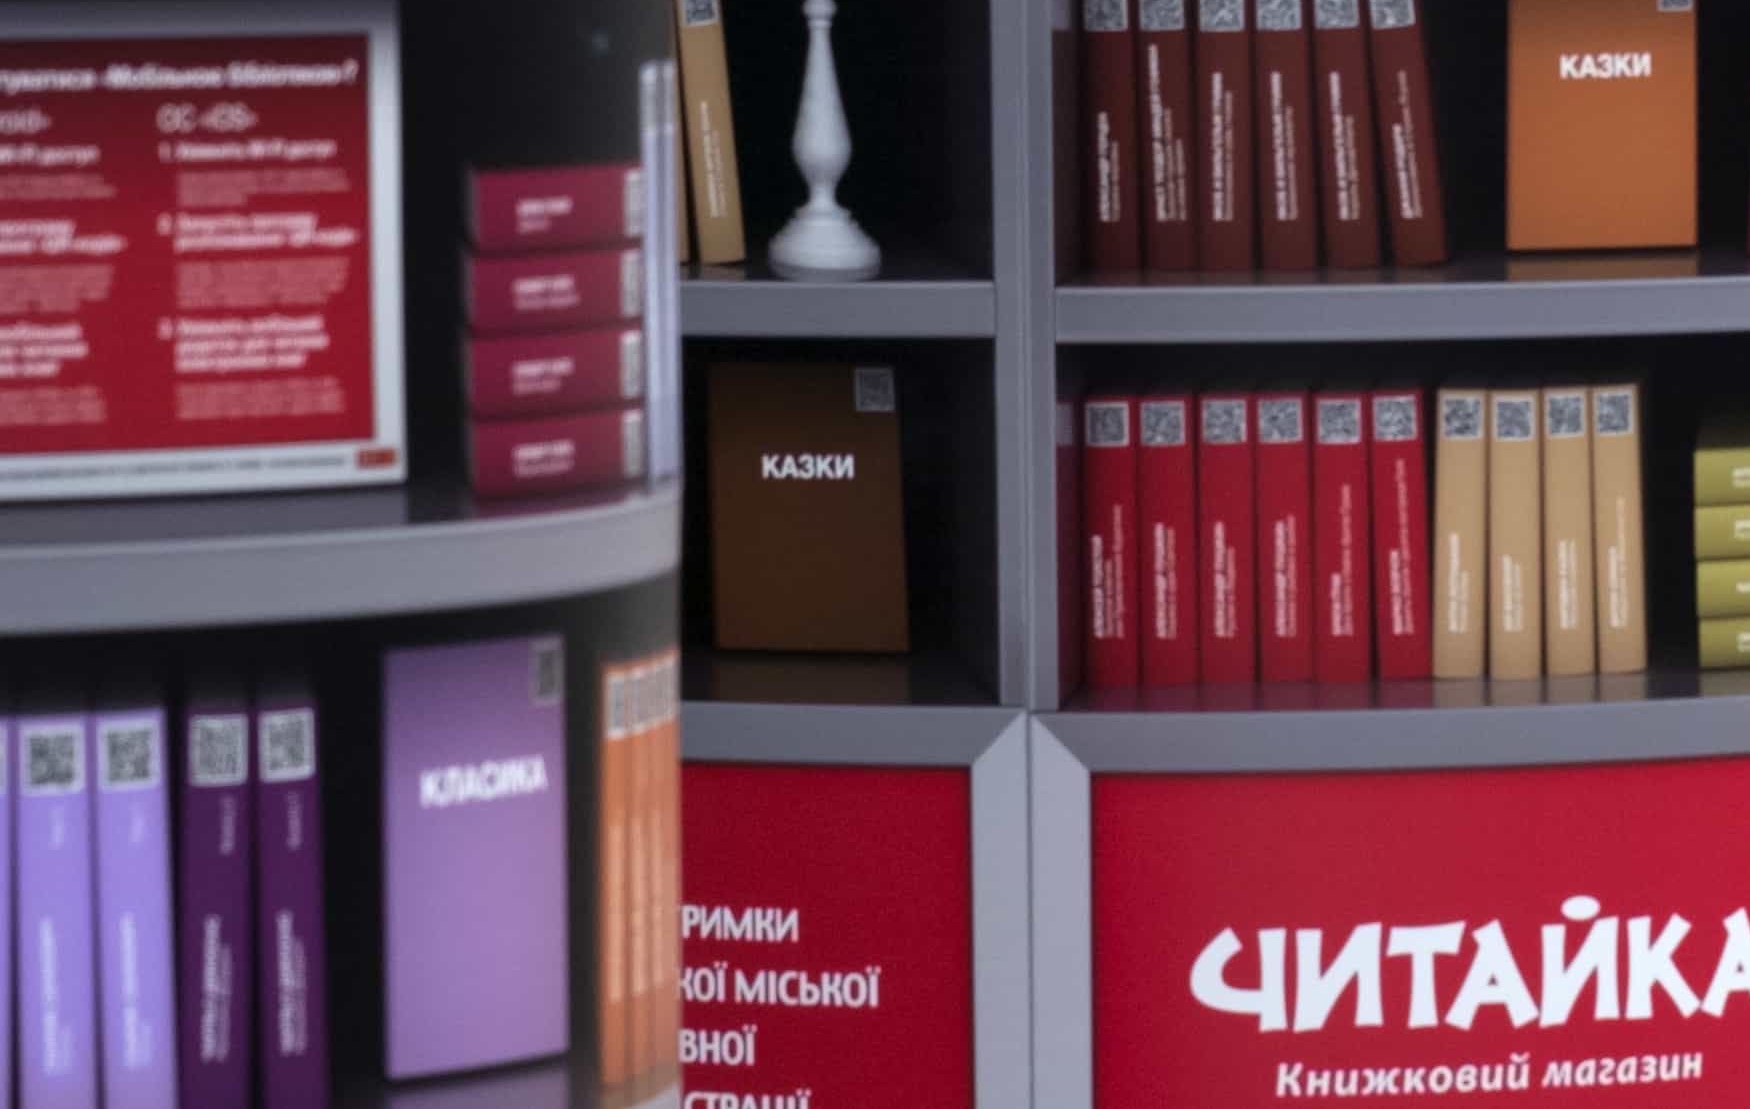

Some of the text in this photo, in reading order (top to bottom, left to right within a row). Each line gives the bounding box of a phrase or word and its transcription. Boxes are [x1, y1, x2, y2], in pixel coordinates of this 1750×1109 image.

[1559, 52, 1652, 79] КАЗКИ
[761, 454, 855, 479] КАЗКИ
[420, 754, 548, 809] КЛАСИКА
[735, 966, 882, 1008] МІСЬКОЇ
[1275, 1051, 1704, 1099] Книжковий магазин
